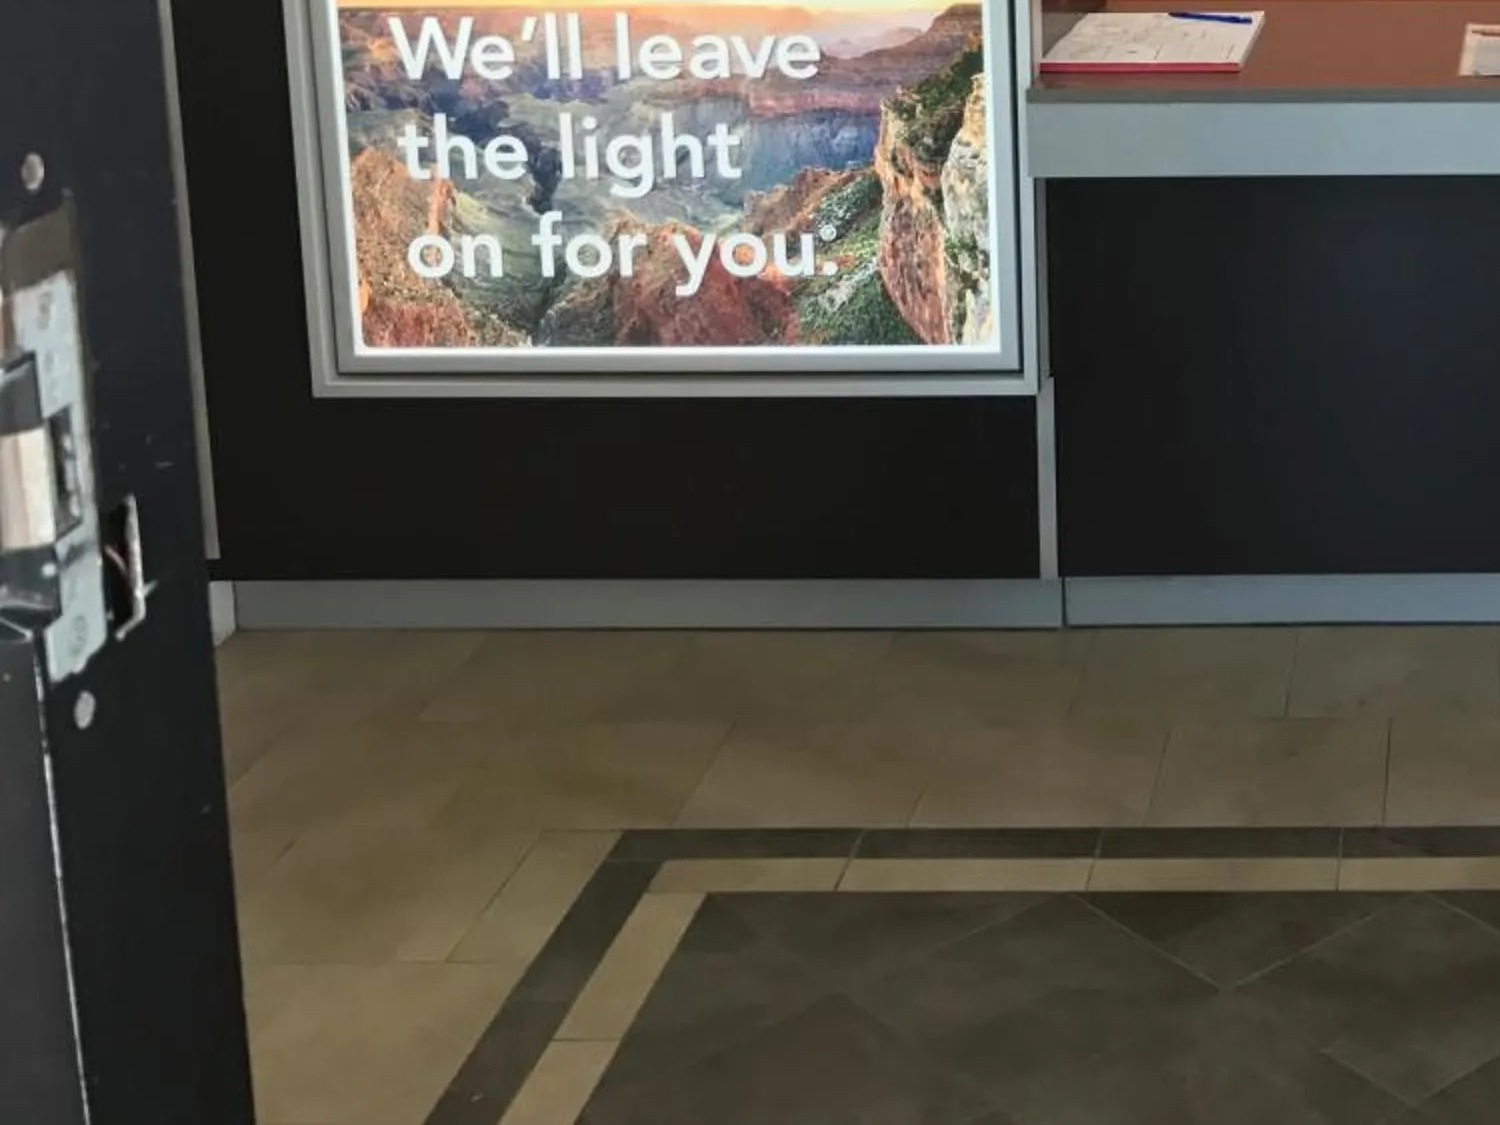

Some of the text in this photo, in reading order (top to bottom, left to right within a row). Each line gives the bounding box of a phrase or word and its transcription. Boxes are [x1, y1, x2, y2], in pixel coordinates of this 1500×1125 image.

[616, 12, 821, 80] leave
[398, 112, 742, 199] the light
[407, 231, 503, 278] on
[532, 210, 647, 278] for
